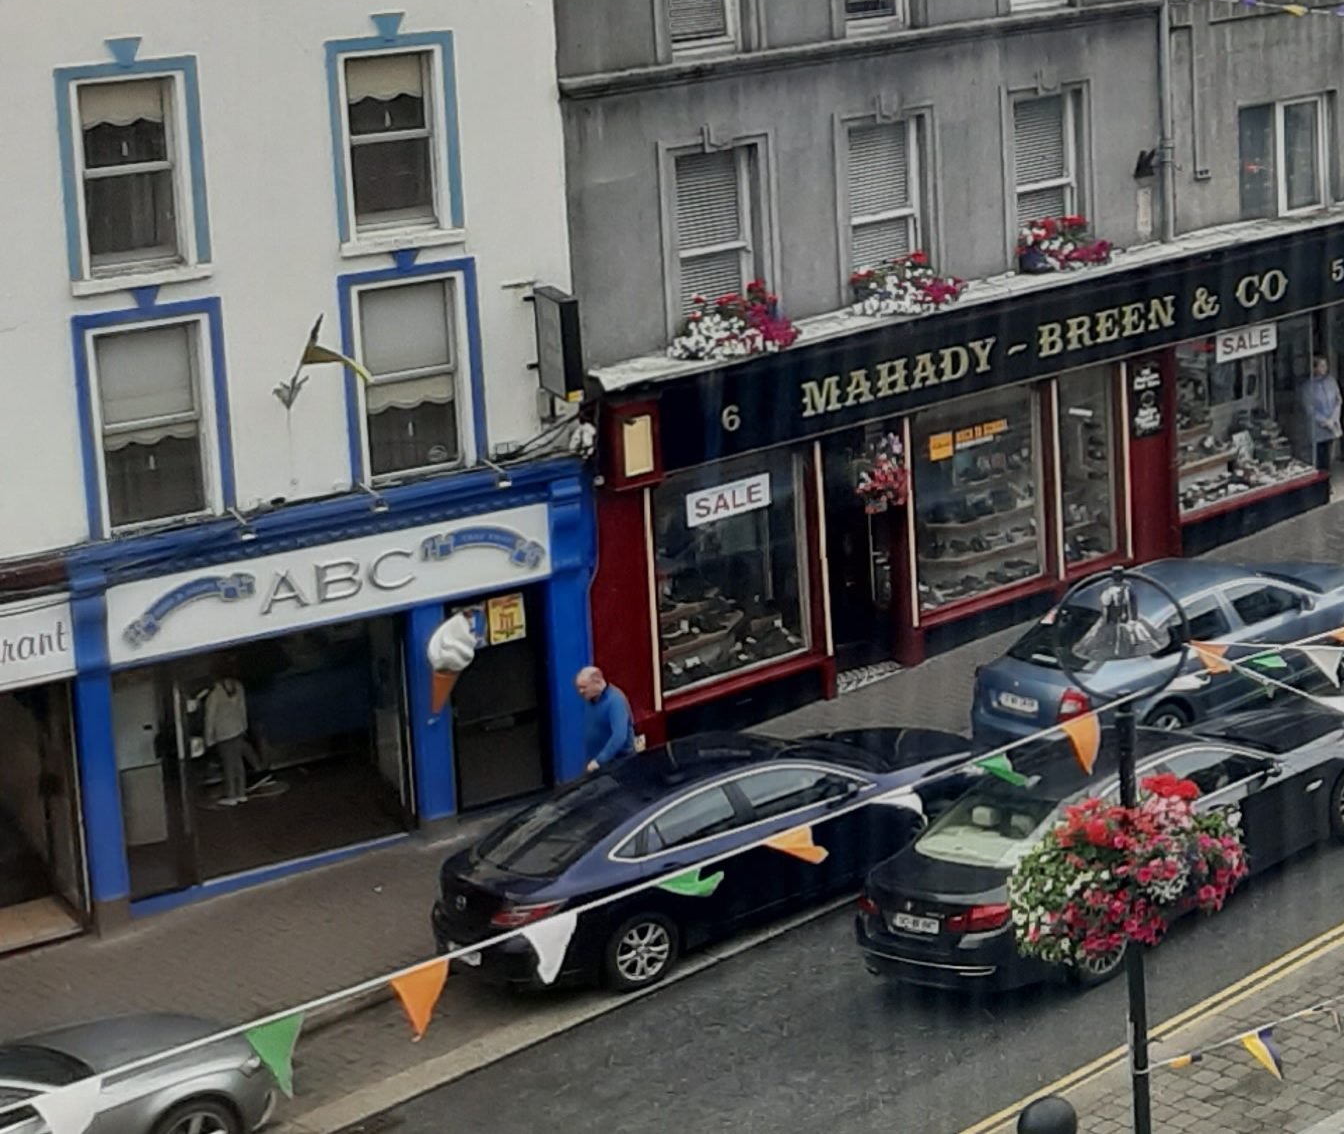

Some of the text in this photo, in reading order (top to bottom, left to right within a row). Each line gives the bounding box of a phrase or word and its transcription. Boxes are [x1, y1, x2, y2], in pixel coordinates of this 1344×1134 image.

[721, 404, 741, 432] 6
[801, 335, 996, 417] MAHADY
[1037, 294, 1176, 359] BREEN
[1191, 286, 1220, 320] &
[1235, 269, 1288, 308] CO
[1222, 327, 1271, 355] SALE
[694, 482, 763, 518] SALE
[260, 548, 416, 616] ABC
[1, 621, 69, 664] rant
